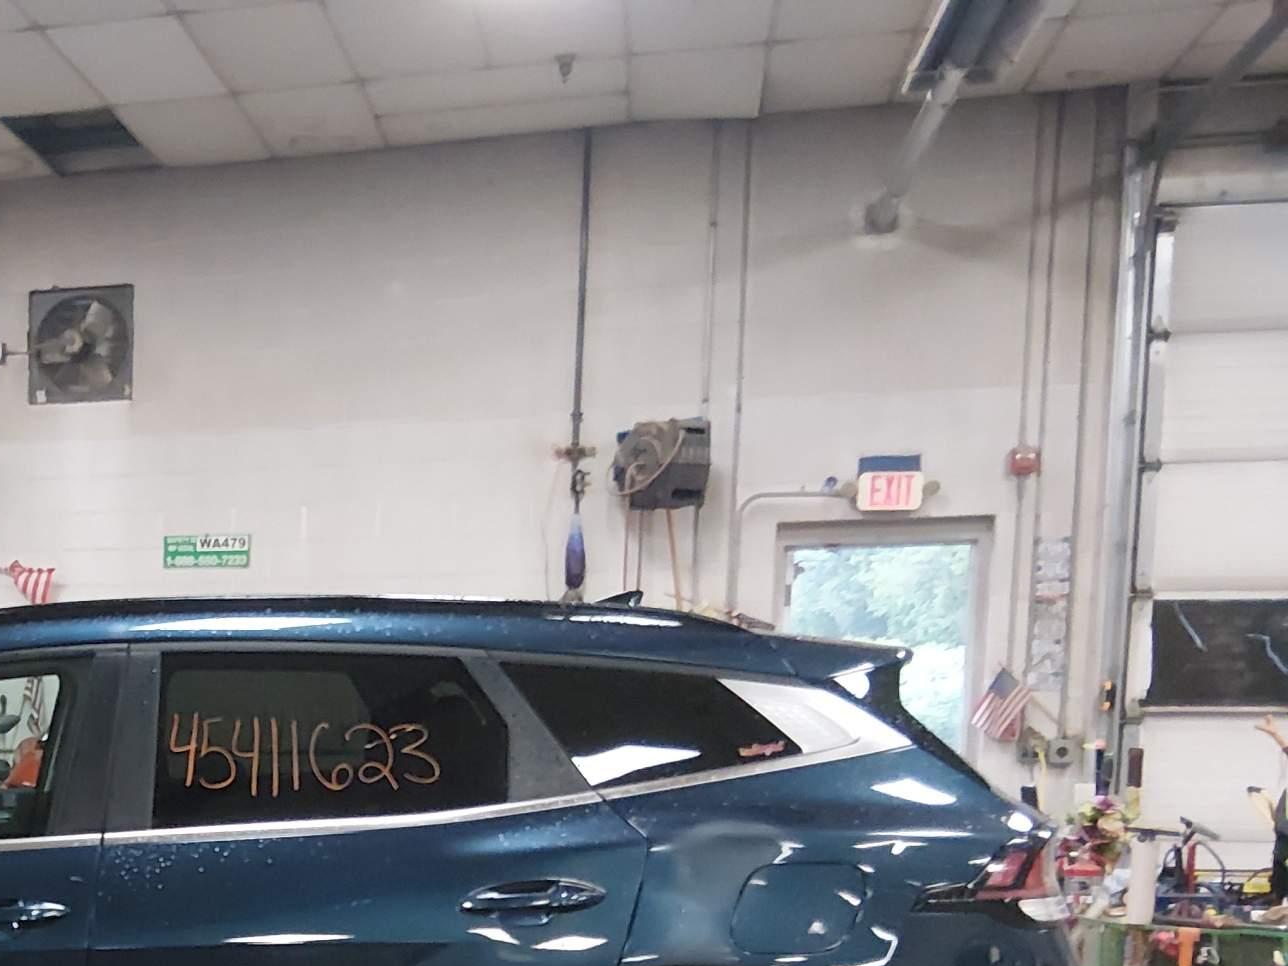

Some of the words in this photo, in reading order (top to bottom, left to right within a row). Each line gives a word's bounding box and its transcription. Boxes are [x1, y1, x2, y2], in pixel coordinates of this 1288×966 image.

[869, 474, 915, 507] EXIT
[198, 537, 247, 549] WA479
[168, 711, 442, 798] 45411623
